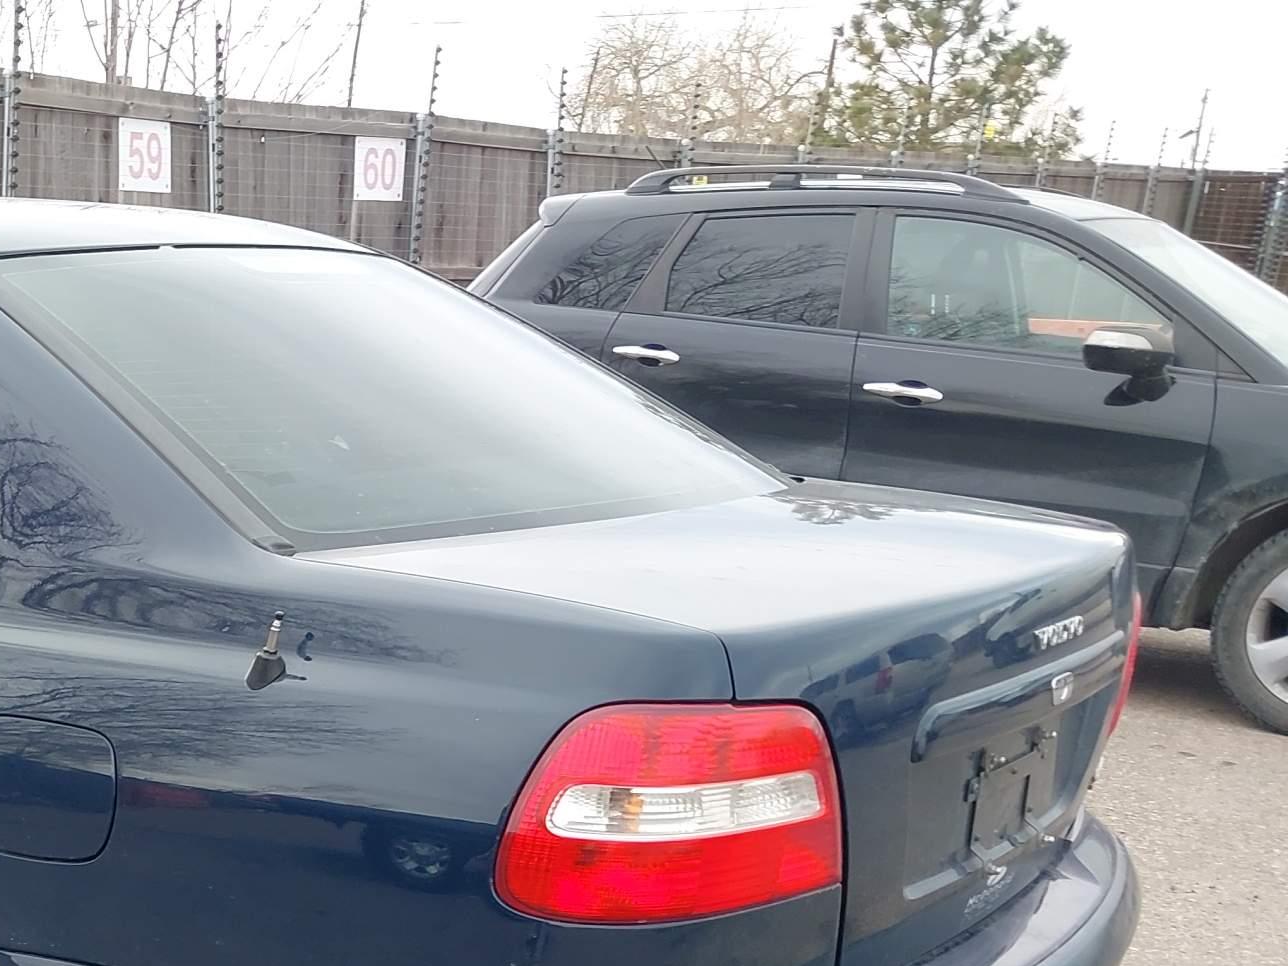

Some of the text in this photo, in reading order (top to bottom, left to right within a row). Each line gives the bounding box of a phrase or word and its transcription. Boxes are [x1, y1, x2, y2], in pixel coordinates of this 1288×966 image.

[128, 131, 163, 181] 59
[363, 147, 397, 191] 60
[1031, 615, 1084, 650] VOLVO
